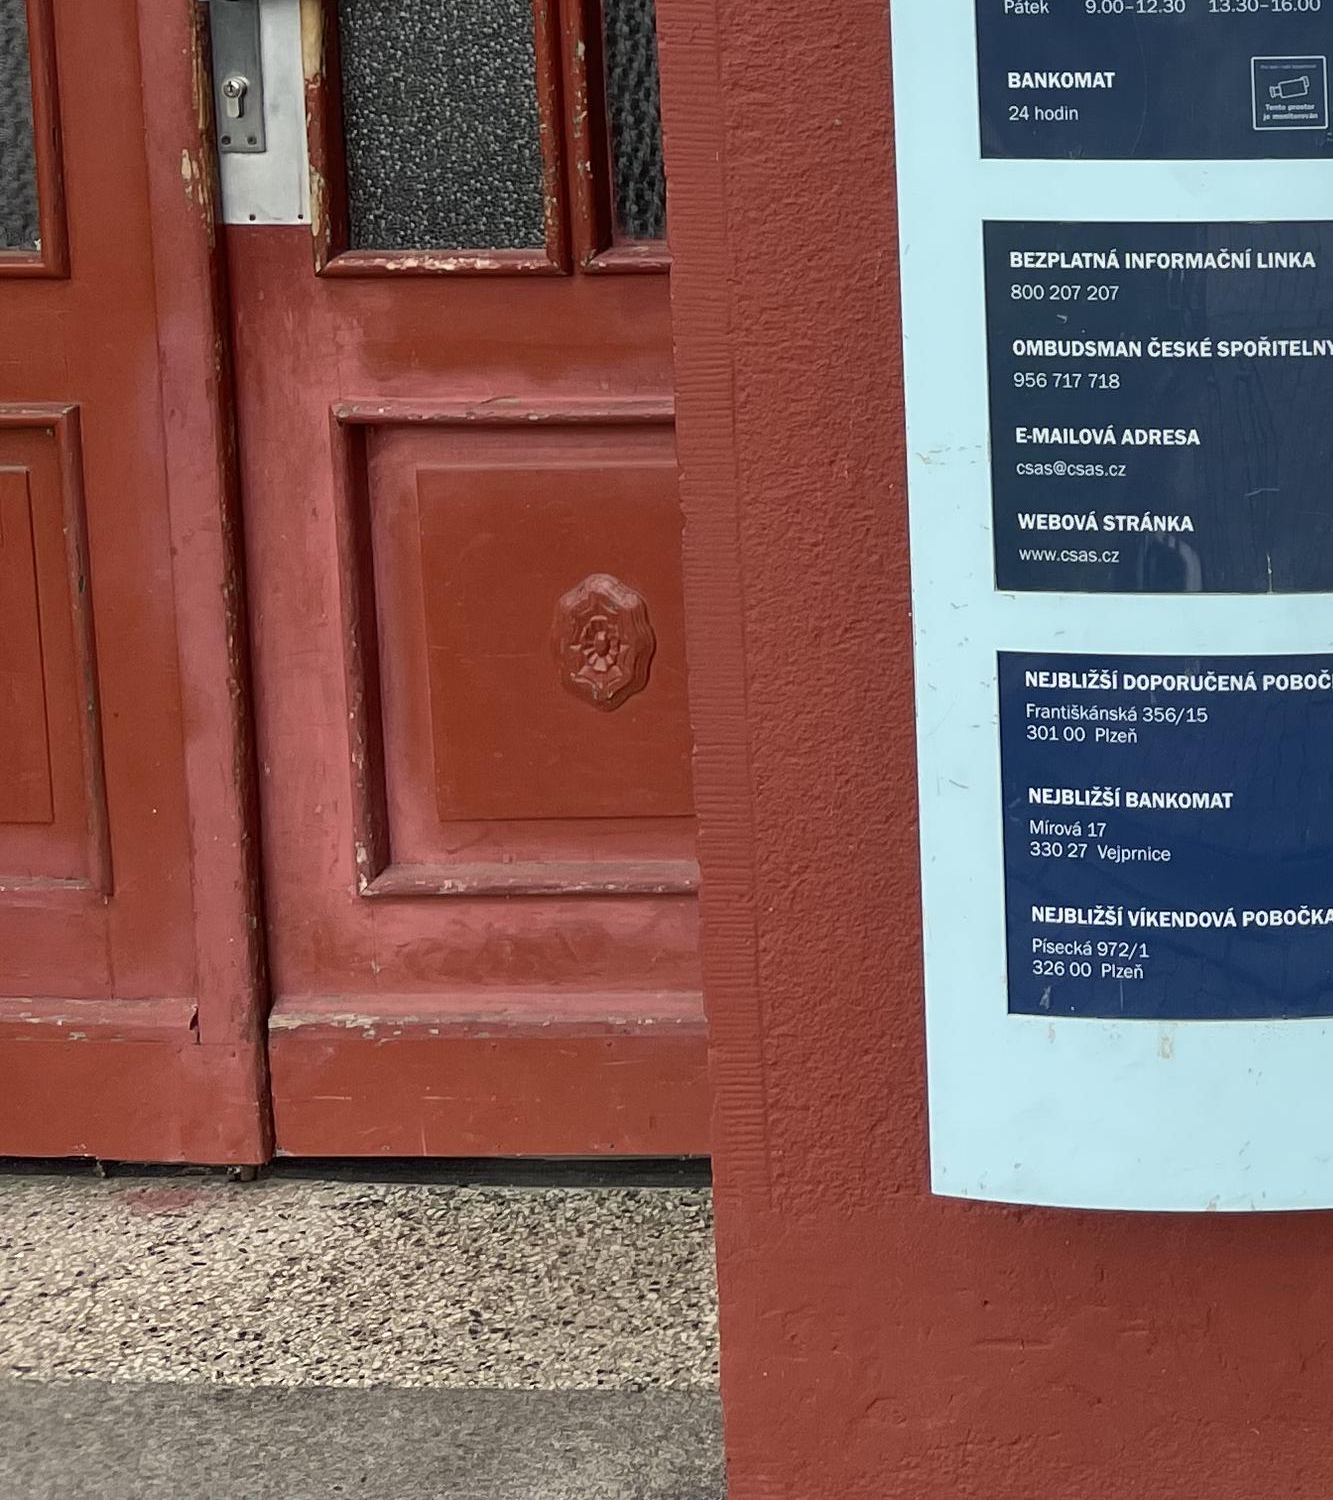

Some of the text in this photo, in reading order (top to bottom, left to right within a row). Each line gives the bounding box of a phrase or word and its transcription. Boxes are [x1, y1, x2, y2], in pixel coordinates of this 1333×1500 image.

[1007, 71, 1115, 89] BANKOMAT
[1008, 104, 1079, 122] 24 hodin
[1010, 248, 1316, 269] BEZPLATNÁ INFORMAČNÍ LINKA
[1010, 285, 1119, 301] 800 207 207
[1012, 340, 1142, 357] OMBUDSMAN
[1148, 336, 1212, 357] ČESKÉ
[1013, 373, 1120, 389] 956 717 718
[1016, 425, 1200, 445] E-MAILOVÁ ADRESA
[1016, 460, 1126, 477] csas@csas.cz
[1018, 511, 1194, 532] WEBOVÁ STRÁNKA
[1019, 549, 1119, 563] www.csas.cz
[1025, 670, 1118, 690] NEJBLIŽŠÍ
[1123, 671, 1257, 691] DOPORUČENÁ
[1026, 704, 1208, 725] Františkánská 356/15
[1026, 726, 1137, 743] 301 00 Plzeň
[1028, 787, 1233, 808] NEJBLIŽŠÍ BANKOMAT
[1030, 819, 1106, 837] Mírová 17
[1030, 842, 1171, 863] 330 27 Vejprnice
[1031, 905, 1123, 926] NEJBLIŽŠÍ
[1128, 908, 1236, 928] VÍKENDOVÁ
[1032, 938, 1149, 959] Písecká 972/1
[1032, 961, 1144, 979] 326 00 Plzeň
